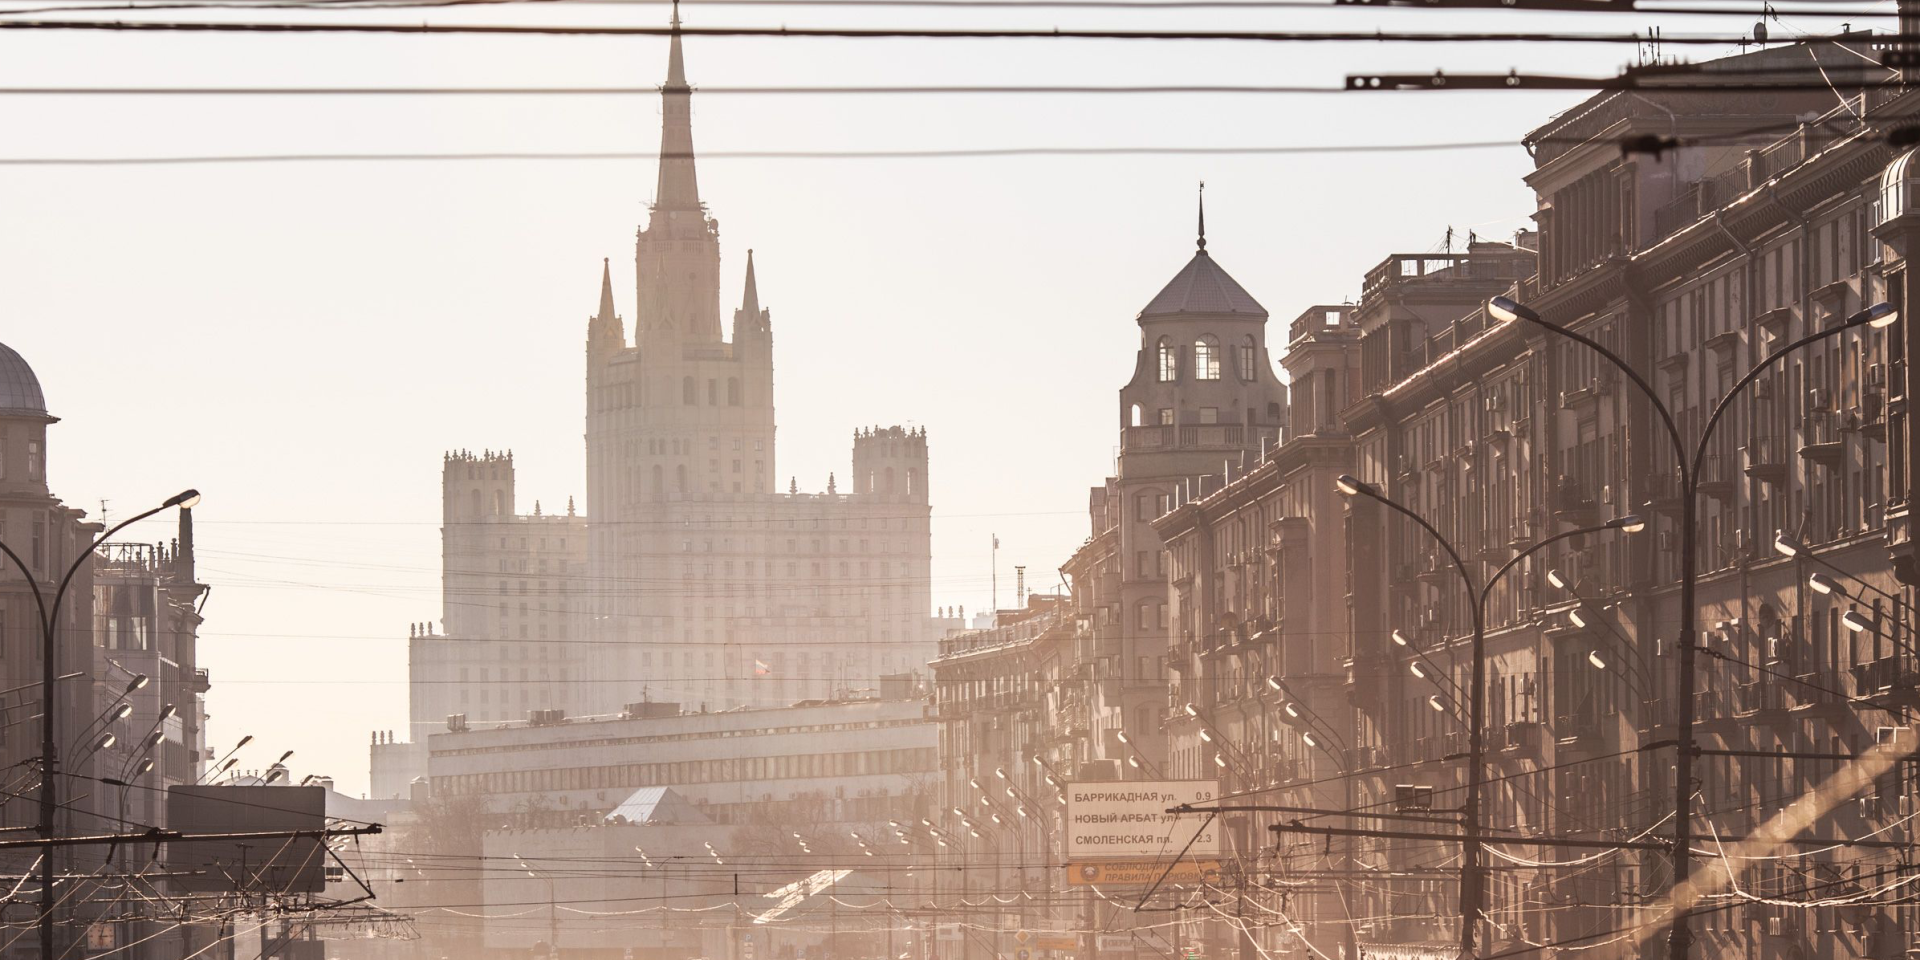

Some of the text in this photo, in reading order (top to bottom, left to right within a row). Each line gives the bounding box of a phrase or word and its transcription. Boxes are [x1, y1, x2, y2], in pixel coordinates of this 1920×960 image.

[1075, 791, 1211, 803] БАРРИКАДНАЯ ул. 0.9
[1075, 812, 1212, 824] НОВЫЙ АРБАТ ул 1.6
[1075, 834, 1212, 845] СМОЛЕНСКАЯ пл. 2.3
[1105, 871, 1206, 881] ПРАВИЛА ПРКОВК
